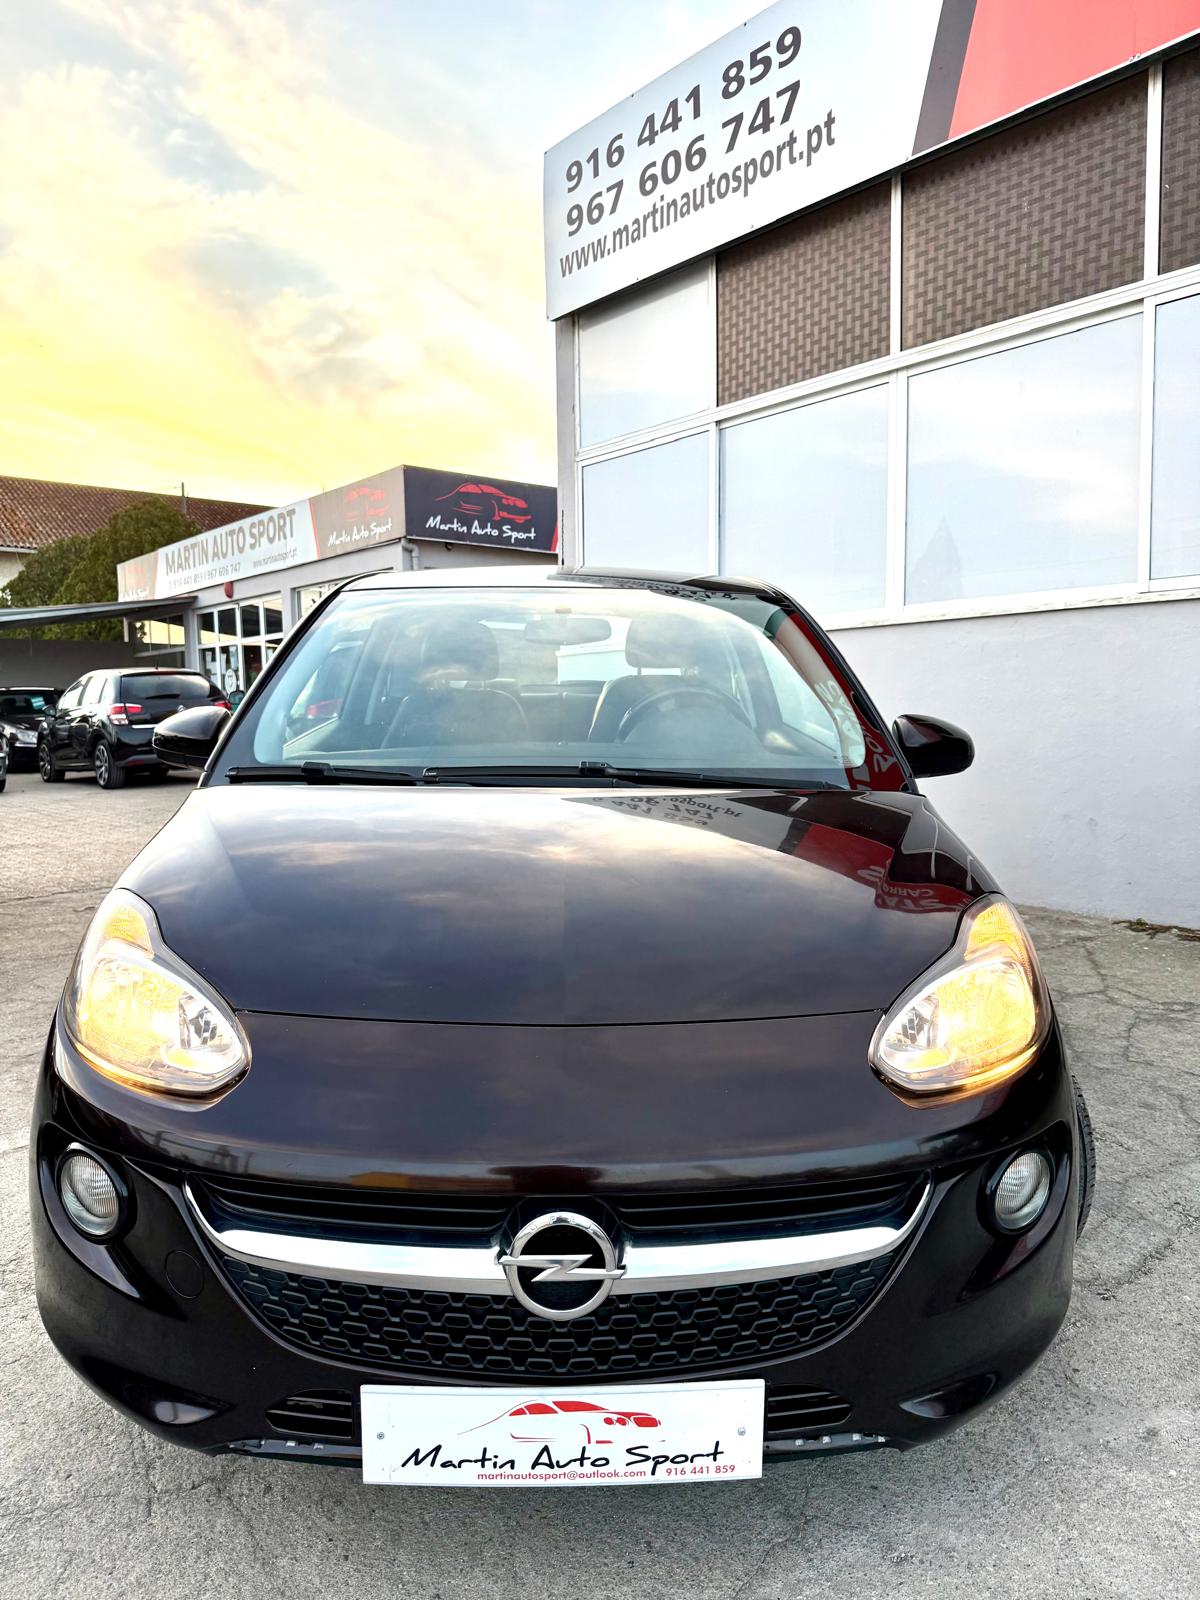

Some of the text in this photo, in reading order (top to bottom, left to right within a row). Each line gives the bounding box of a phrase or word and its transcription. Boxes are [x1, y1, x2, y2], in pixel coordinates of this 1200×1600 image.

[566, 26, 802, 193] 916 441 859
[566, 80, 801, 238] 967 606 747
[559, 108, 836, 278] www.martinautosport.pt
[165, 508, 296, 576] MARTIN AUTO SPORT
[352, 525, 369, 541] Auto
[370, 517, 392, 541] Sport
[425, 514, 536, 543] Martin Auto Sport
[230, 561, 241, 575] 747
[401, 1440, 724, 1476] Martin Auto Sport
[477, 1464, 736, 1481] martinautosport@outlook.com 916 441 859
